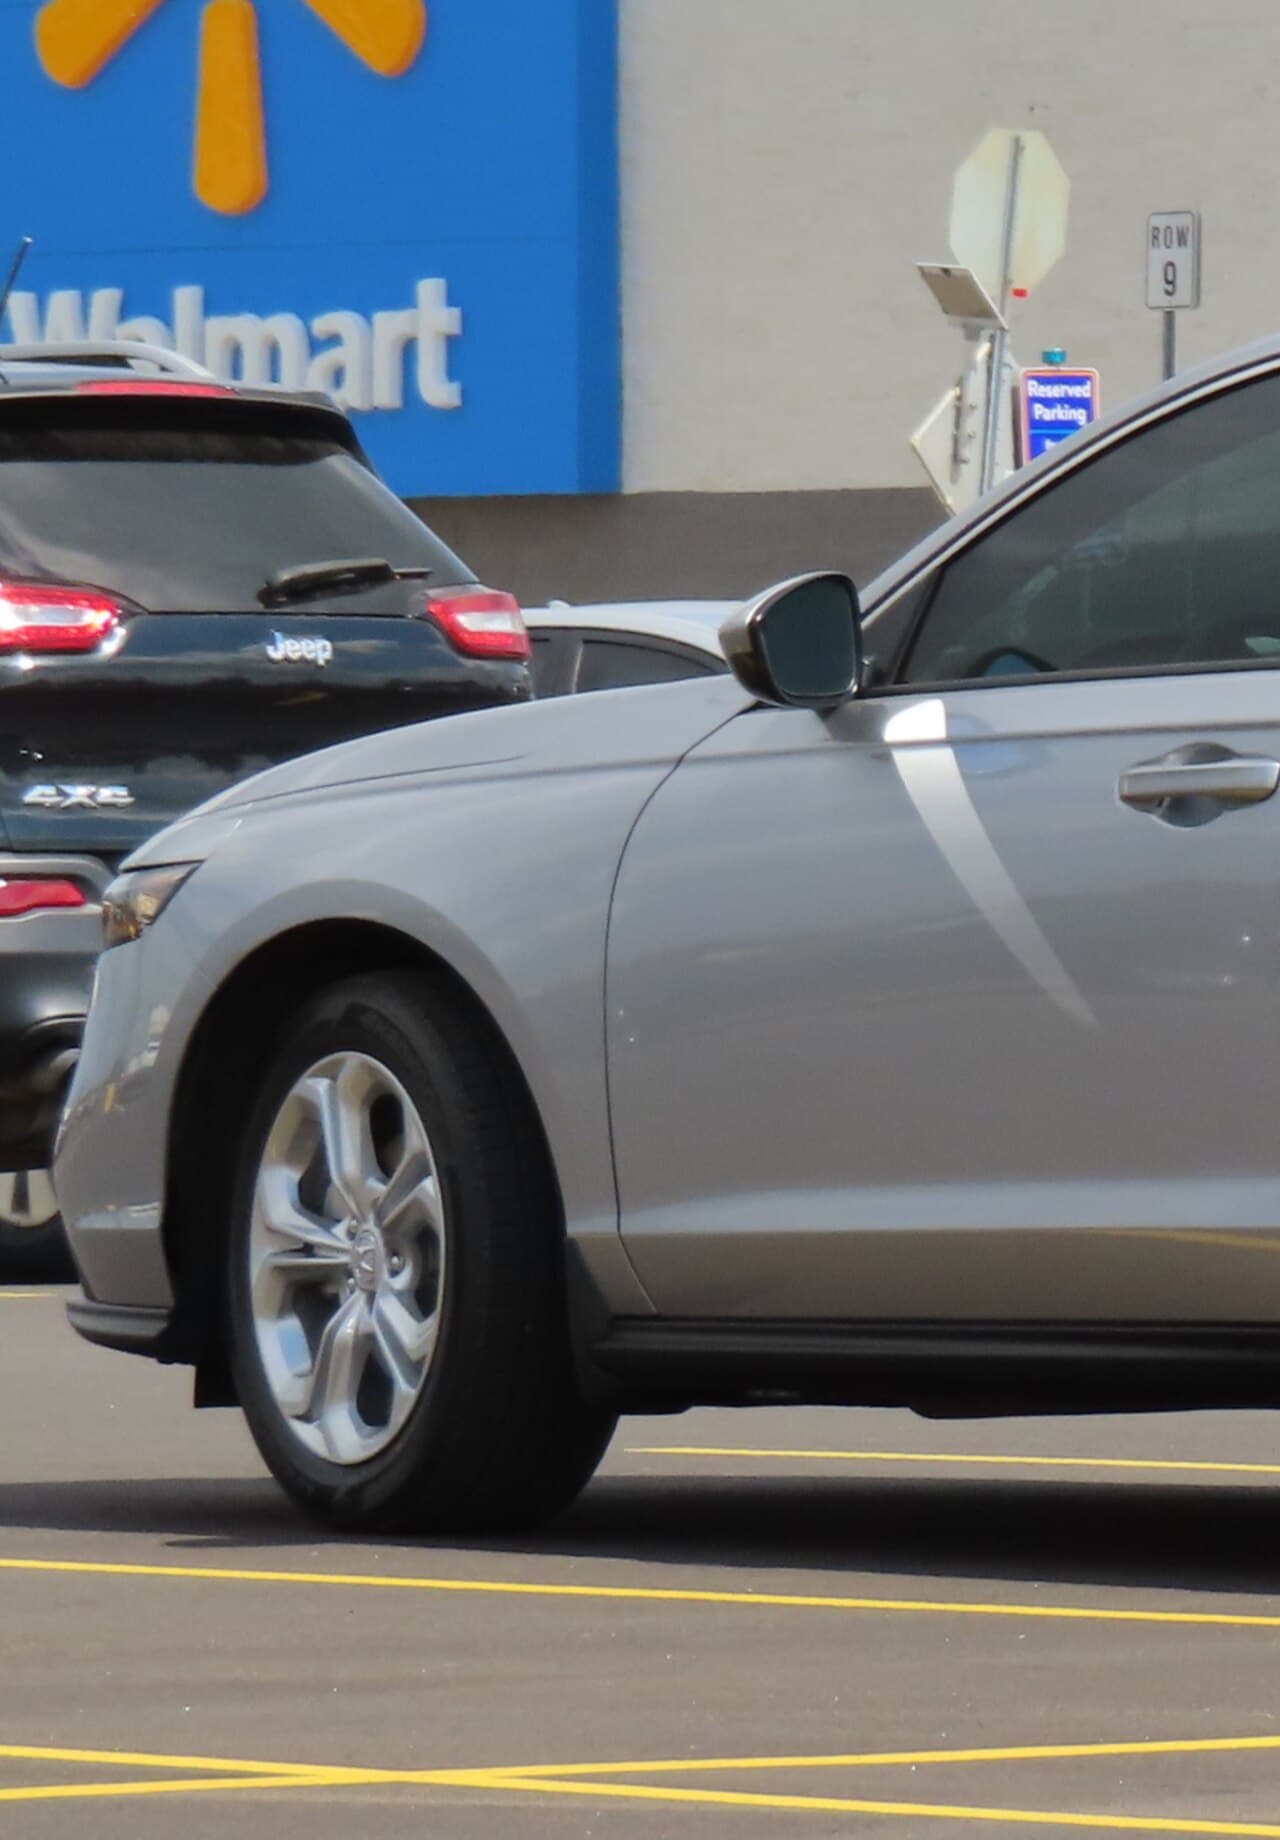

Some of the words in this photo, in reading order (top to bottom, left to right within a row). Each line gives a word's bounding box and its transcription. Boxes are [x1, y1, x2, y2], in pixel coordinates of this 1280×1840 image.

[1151, 225, 1190, 249] ROW
[1163, 261, 1177, 297] 9
[1027, 379, 1092, 398] Reserved
[1033, 403, 1087, 425] Parking
[266, 629, 333, 667] Jeep
